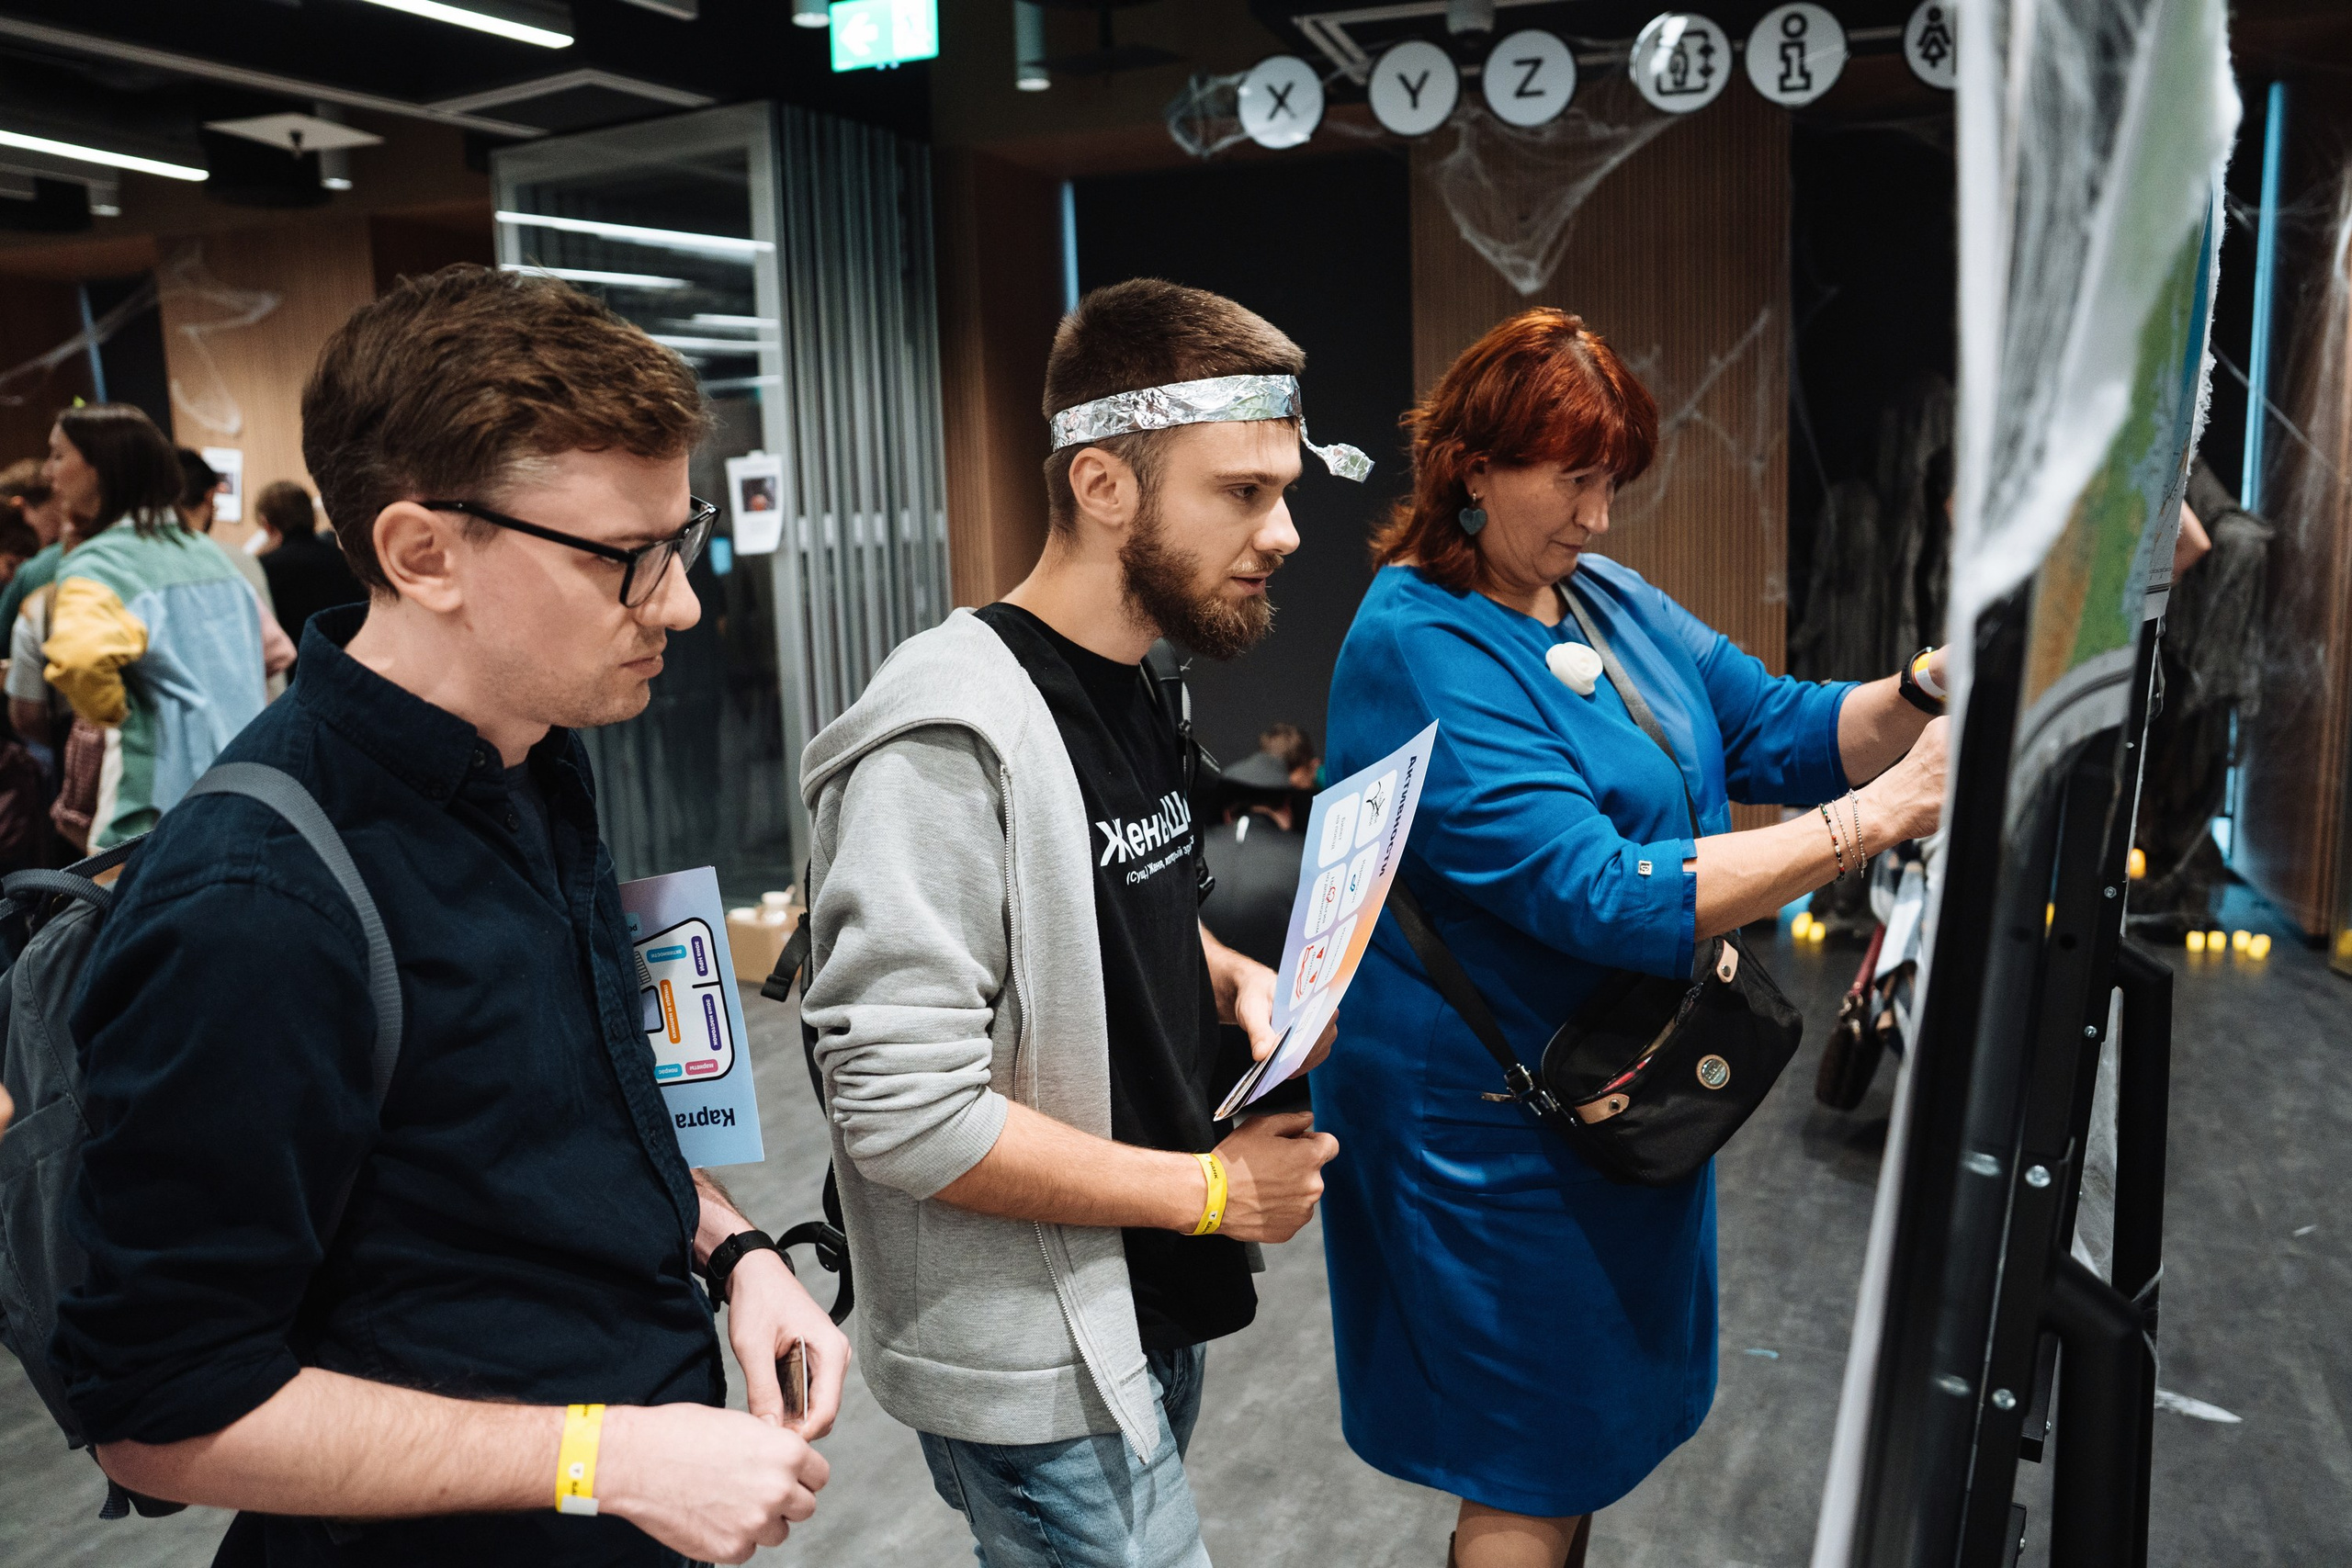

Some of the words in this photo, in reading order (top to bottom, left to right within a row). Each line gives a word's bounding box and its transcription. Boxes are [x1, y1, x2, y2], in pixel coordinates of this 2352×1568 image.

[1396, 70, 1431, 110] Y
[1512, 57, 1545, 99] Z
[1266, 80, 1297, 120] X
[1094, 790, 1192, 867] ЖеньШ
[674, 1106, 735, 1129] Карта
